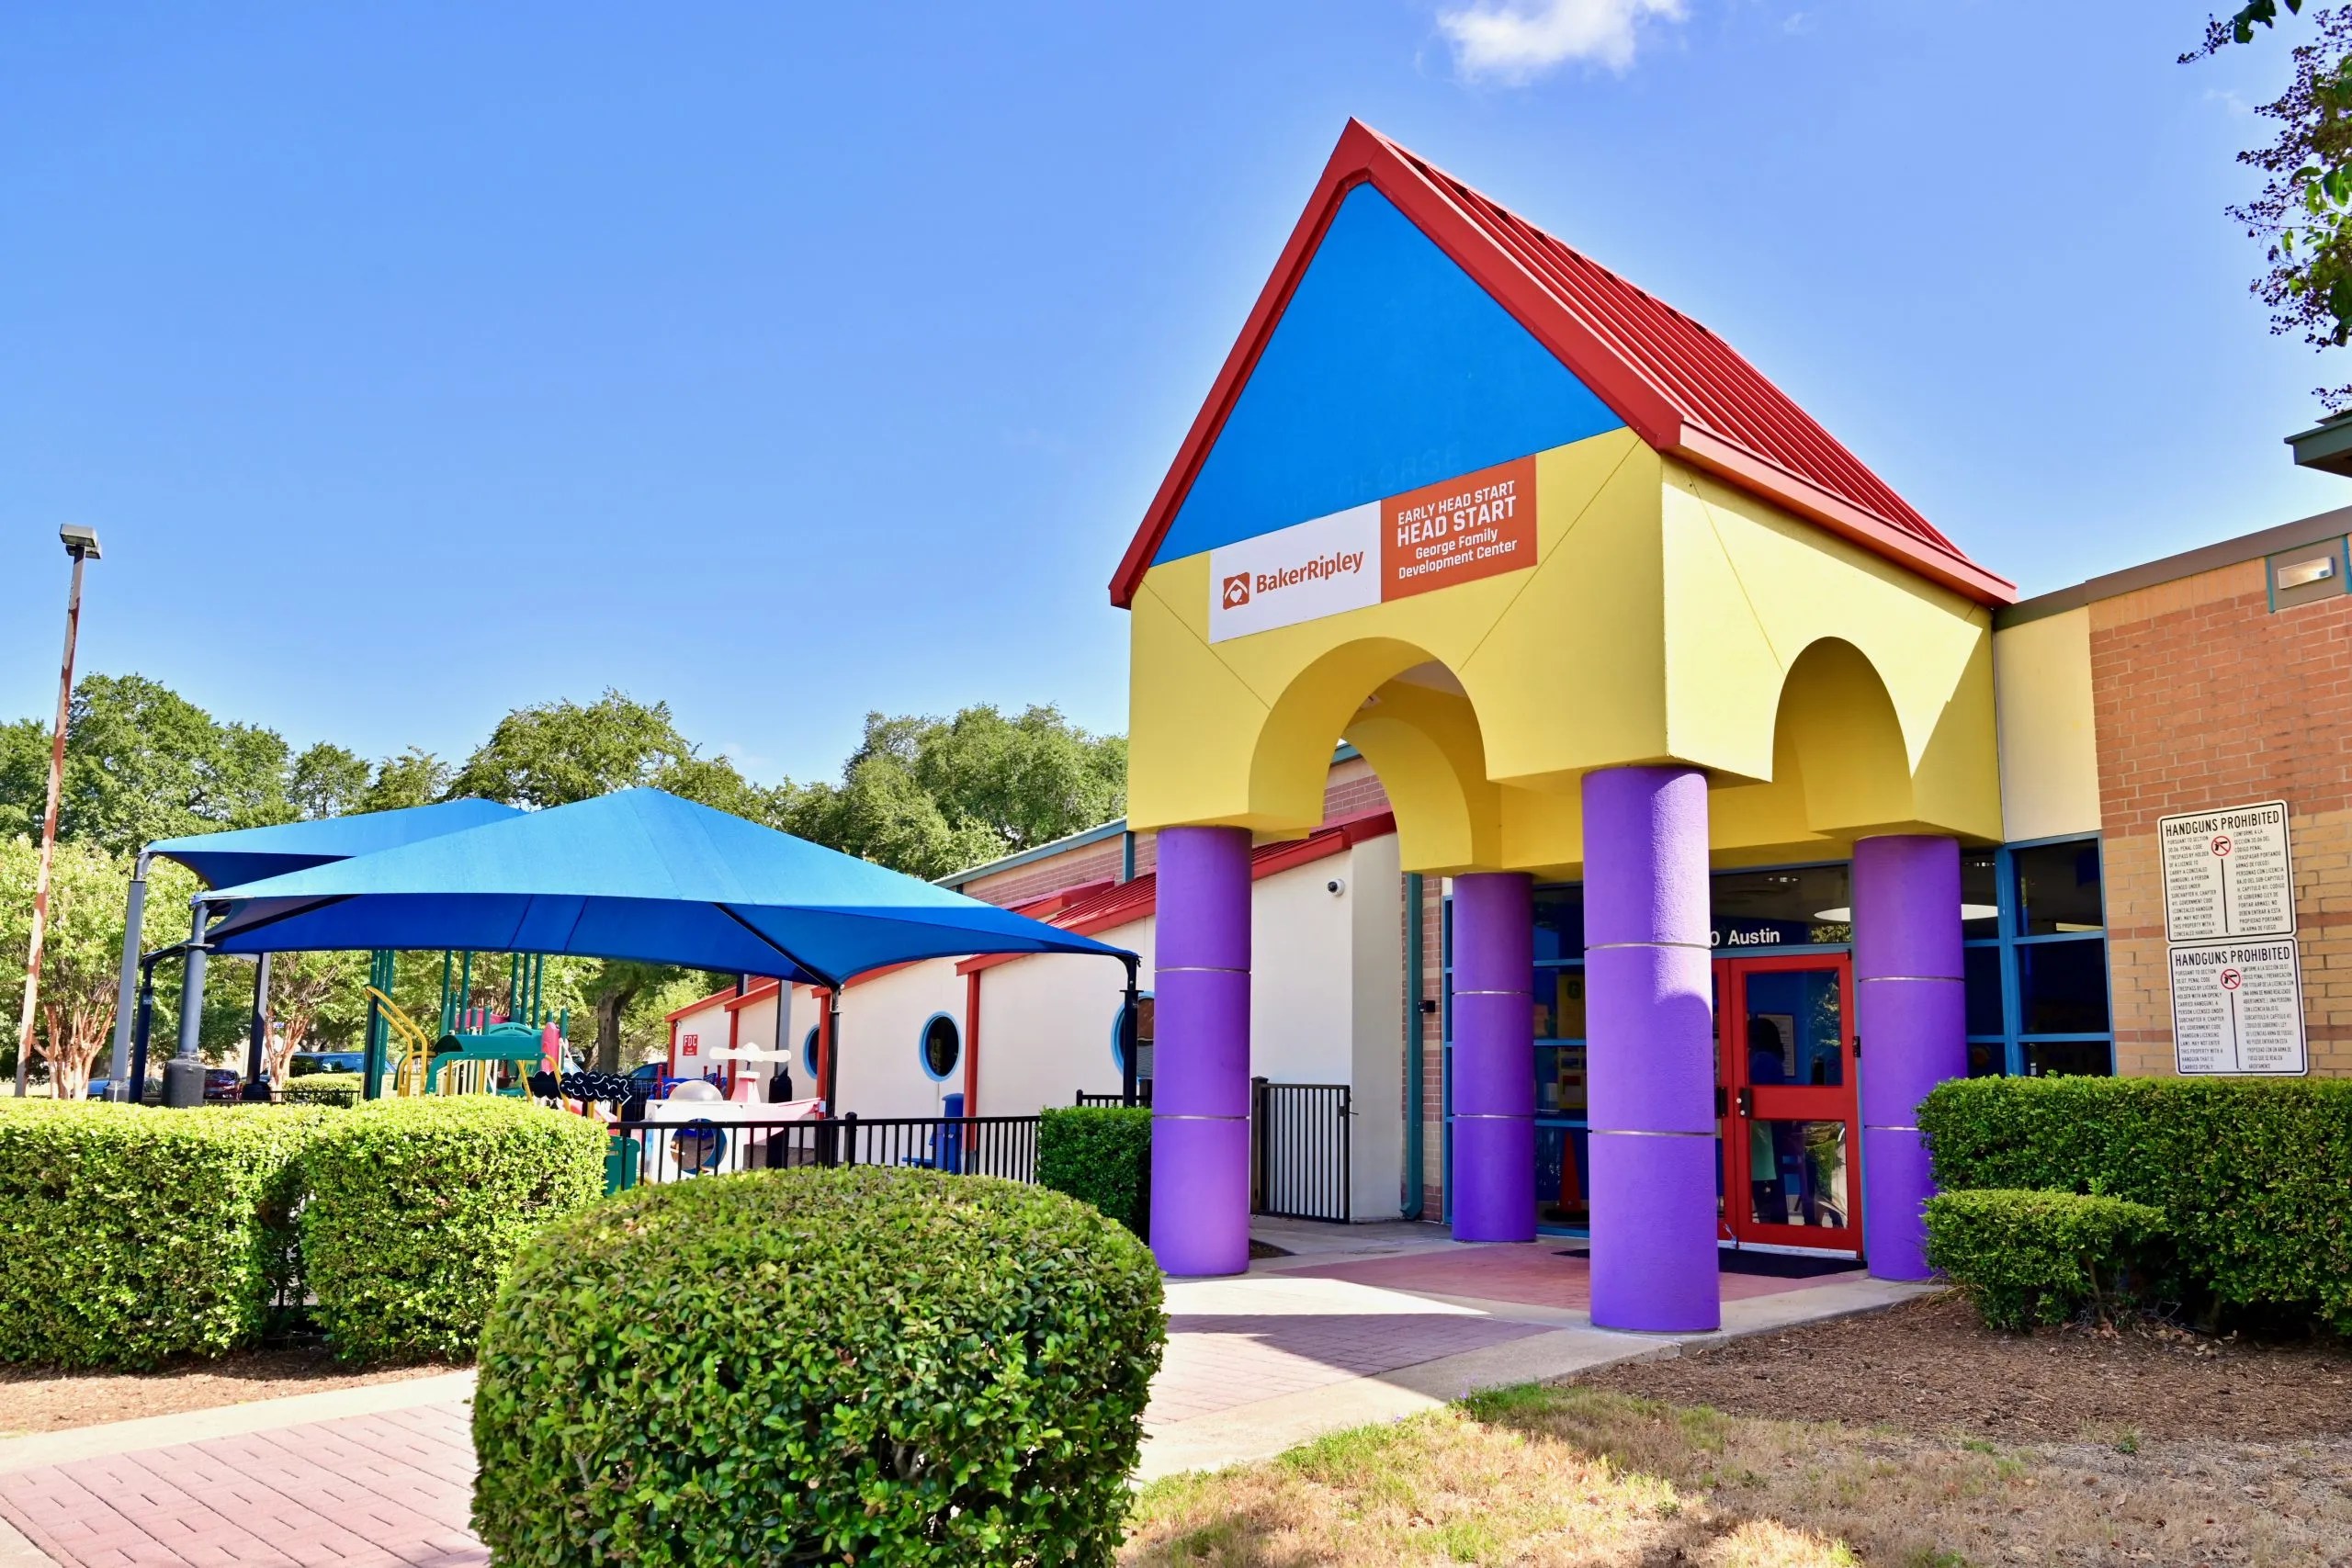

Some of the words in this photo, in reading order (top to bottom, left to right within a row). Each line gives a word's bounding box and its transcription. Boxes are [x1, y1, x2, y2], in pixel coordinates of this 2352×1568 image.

[1398, 503, 1435, 525] EARLY
[1439, 494, 1471, 513] HEAD
[1475, 480, 1514, 503] START
[1397, 516, 1447, 547] HEAD
[1453, 496, 1516, 531] START
[1416, 540, 1455, 558] George
[1459, 528, 1498, 547] Family
[1257, 551, 1363, 593] BakerRipley
[1398, 549, 1474, 579] Development
[1477, 540, 1517, 558] Center
[2165, 819, 2217, 837] HANDGUNS
[2222, 811, 2279, 829] PROHIBITED
[1728, 928, 1780, 945] Austin
[2176, 952, 2227, 966] HANDGUNS
[2231, 947, 2290, 963] PROHIBITED
[684, 1036, 696, 1046] FDC
